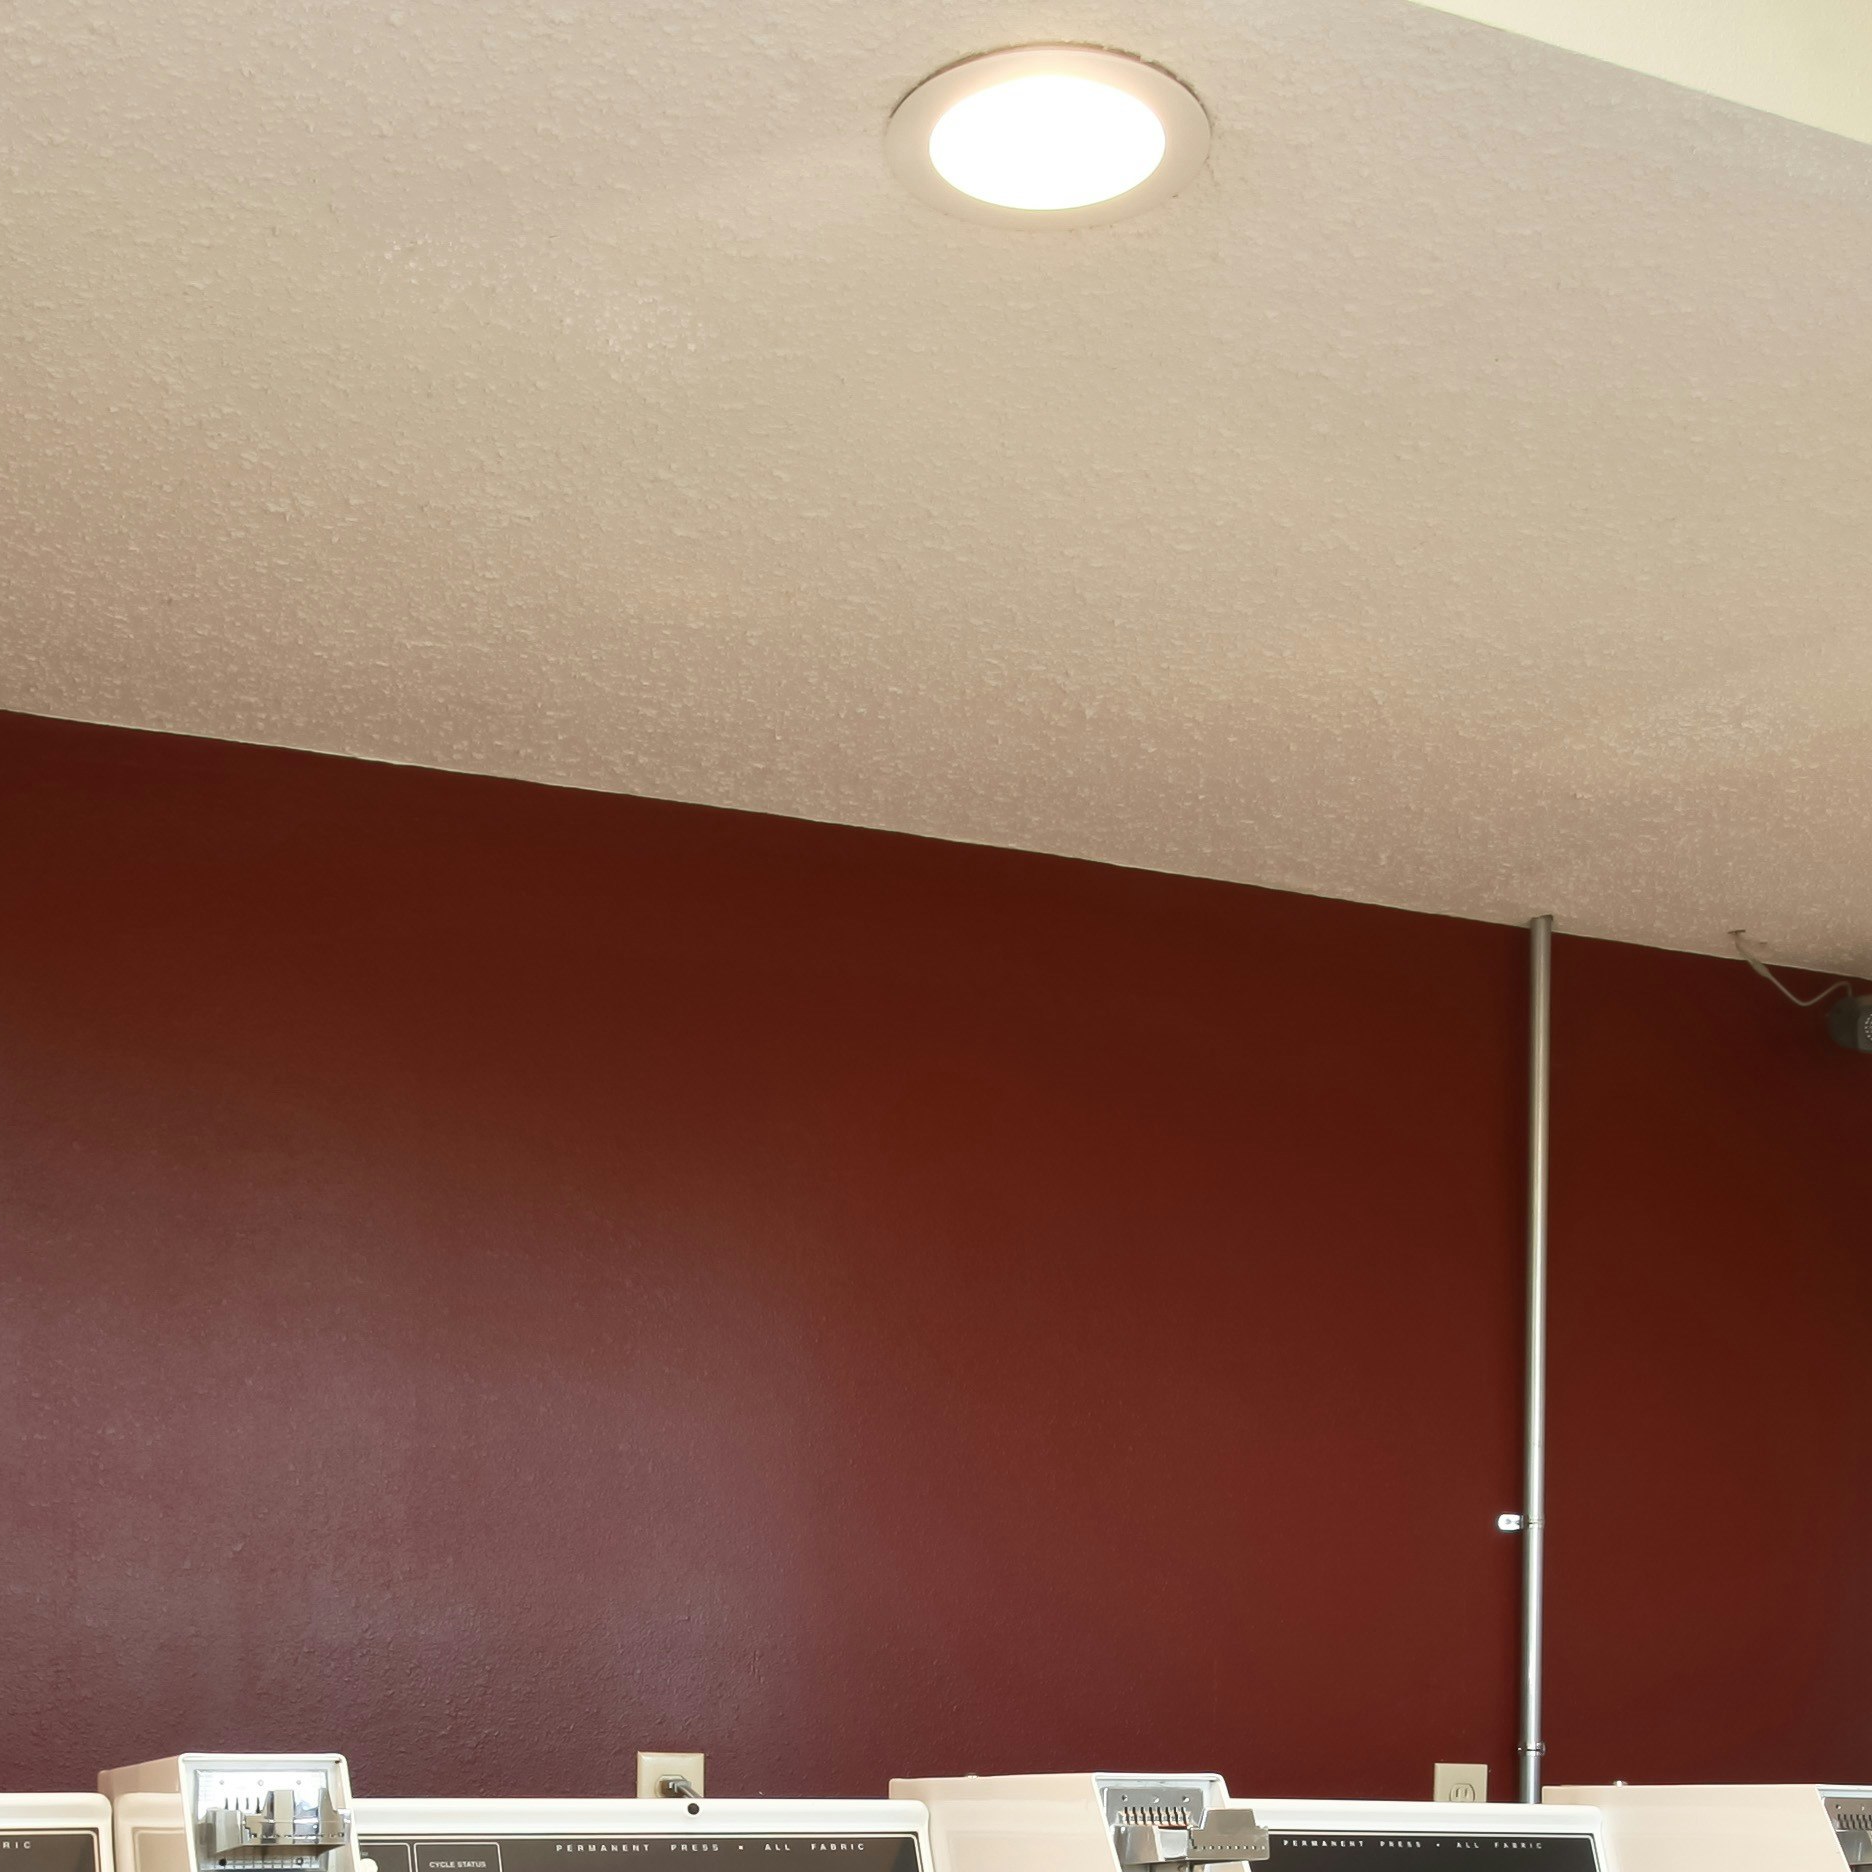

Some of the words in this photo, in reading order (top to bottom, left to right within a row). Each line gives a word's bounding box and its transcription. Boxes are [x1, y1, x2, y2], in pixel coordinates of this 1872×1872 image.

[1283, 1839, 1364, 1847] PERMANENT
[556, 1843, 650, 1852] PERMANENT
[671, 1843, 719, 1852] PRESS
[765, 1843, 791, 1852] ALL
[811, 1843, 865, 1851] FABRIC
